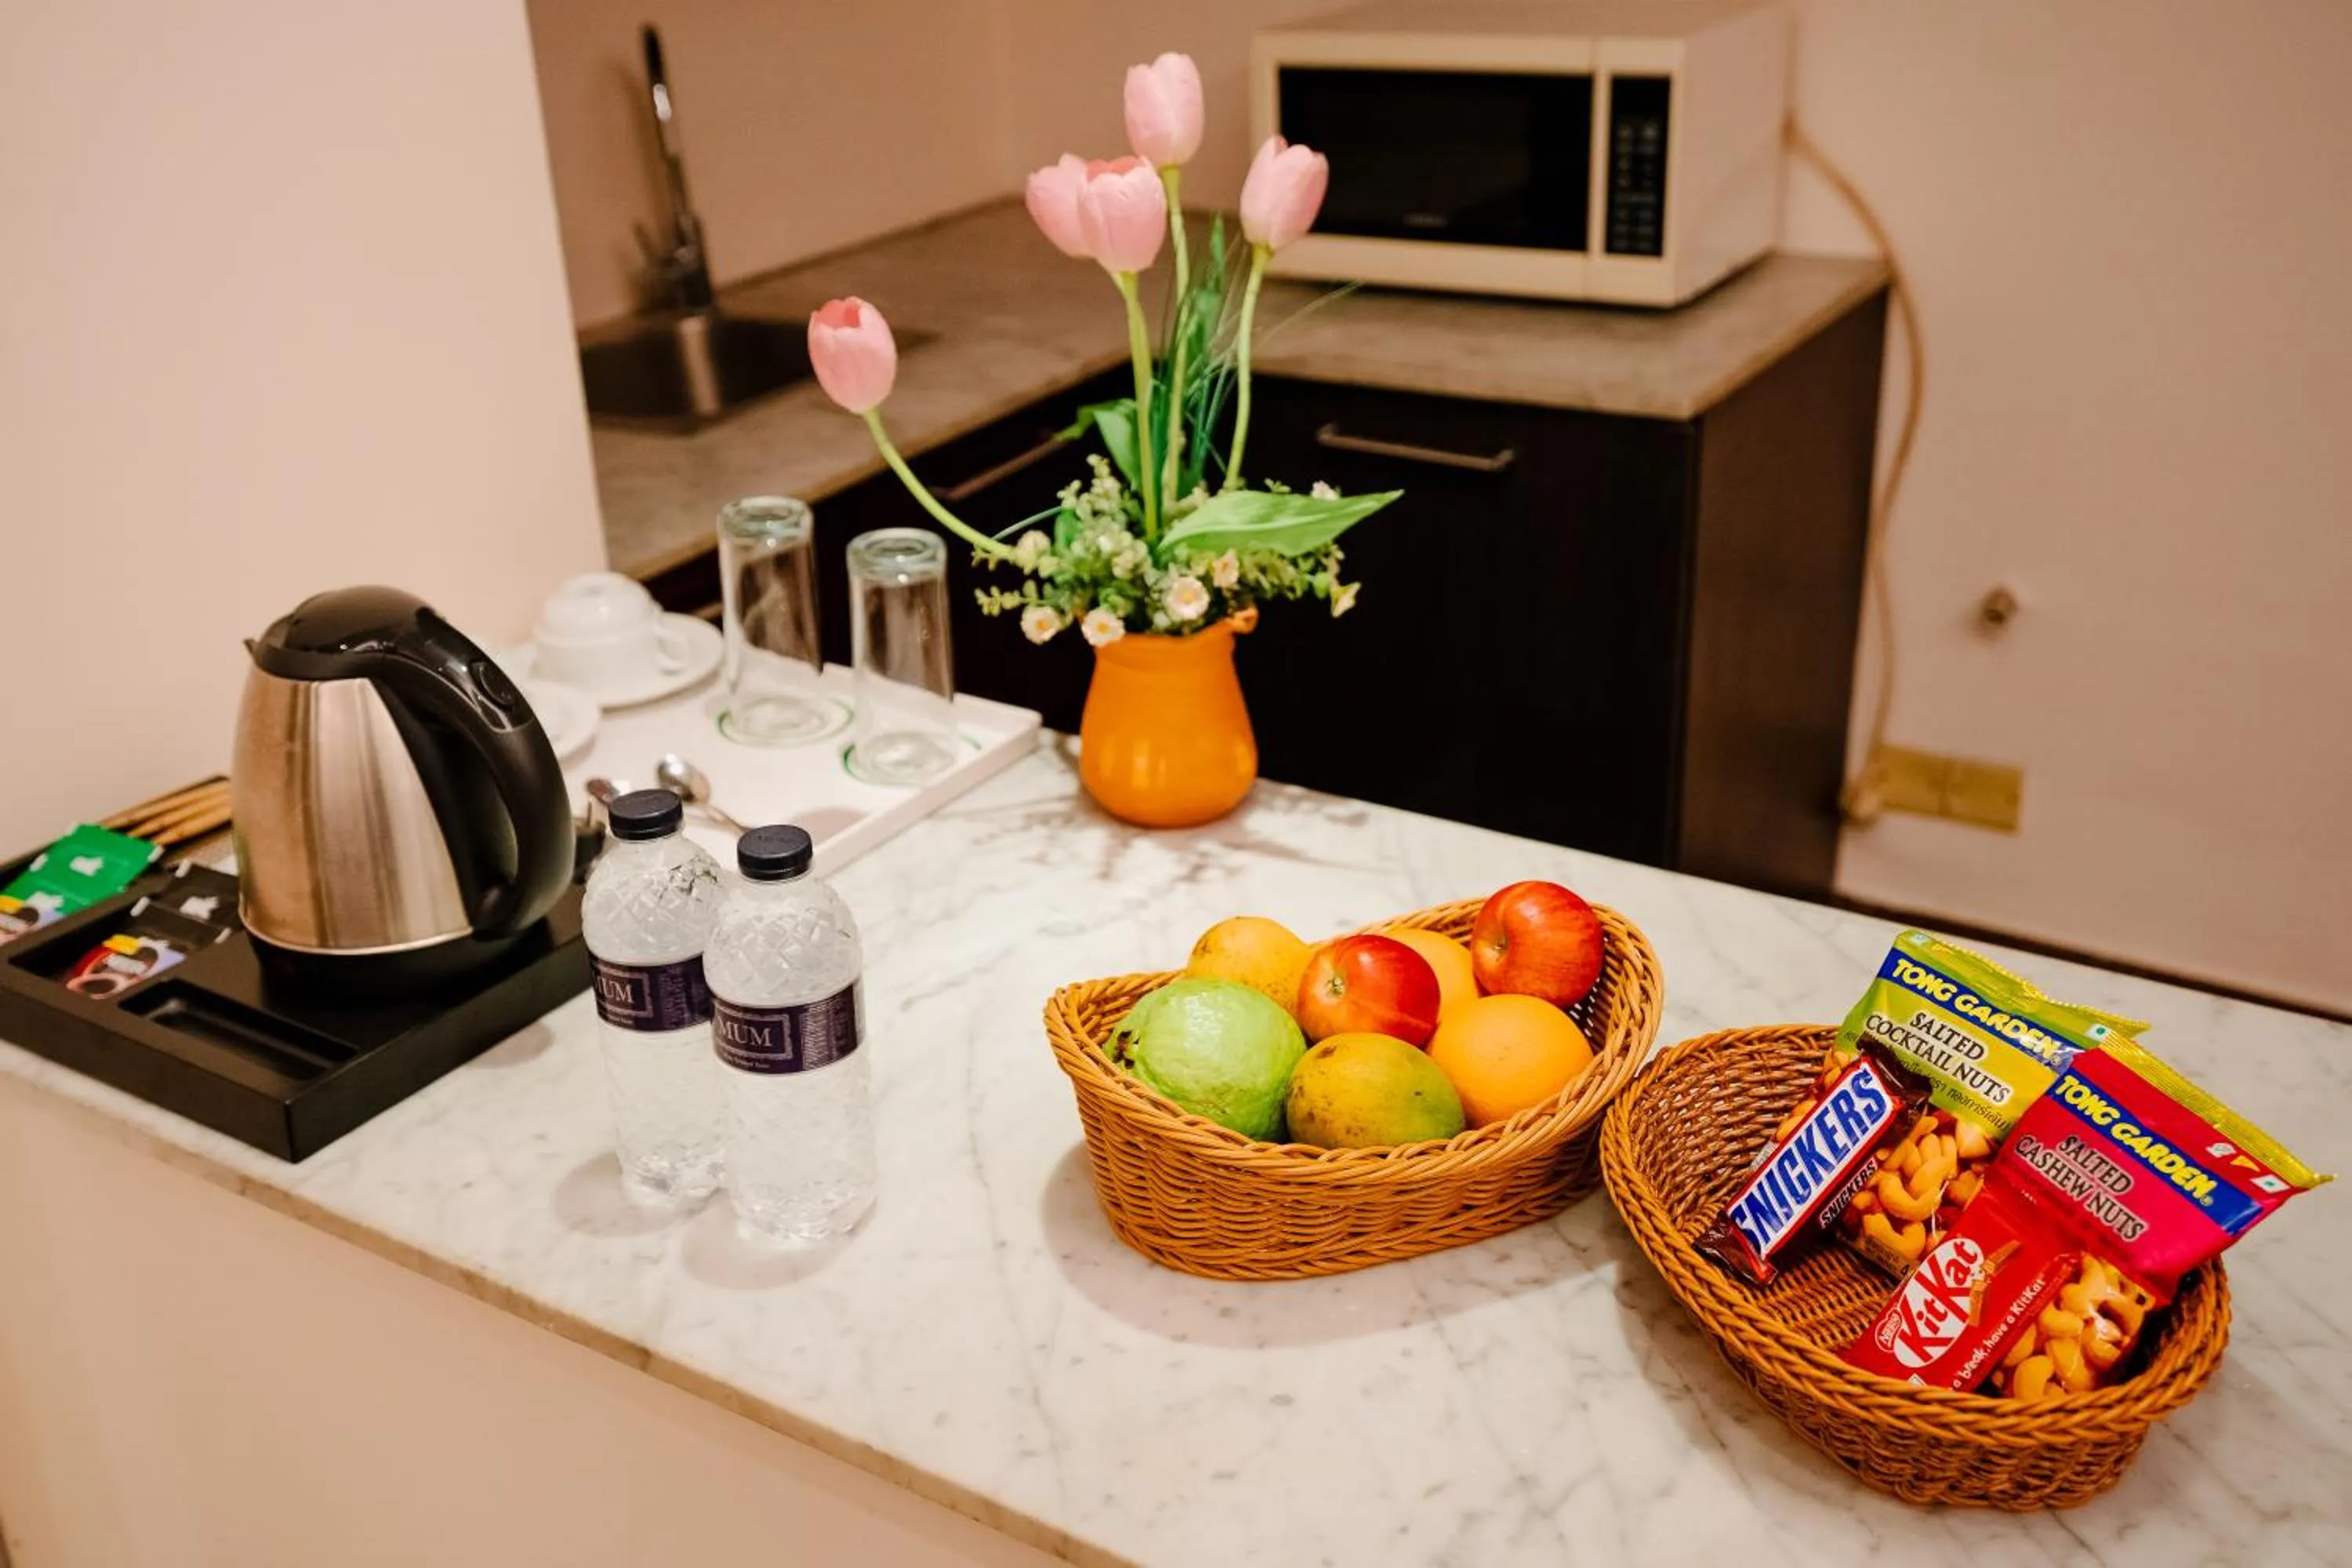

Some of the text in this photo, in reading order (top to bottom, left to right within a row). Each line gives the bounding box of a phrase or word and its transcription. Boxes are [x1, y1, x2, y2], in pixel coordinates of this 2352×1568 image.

[1892, 958, 2062, 1058] TONG GARDEN
[1908, 1013, 1985, 1060] SALTED
[1866, 1014, 1955, 1072] COCKTAIL
[1953, 1062, 2012, 1103] NUTS
[1730, 1068, 1887, 1256] SNICKERS
[2055, 1075, 2218, 1200] TONG GARDEN
[2058, 1135, 2132, 1193] SALTED
[1819, 1156, 1878, 1229] SNICKERS
[2016, 1135, 2145, 1240] CASHEW NUTS
[2006, 1315, 2016, 1325] a
[2009, 1279, 2045, 1317] KitKat
[1983, 1323, 2009, 1350] have
